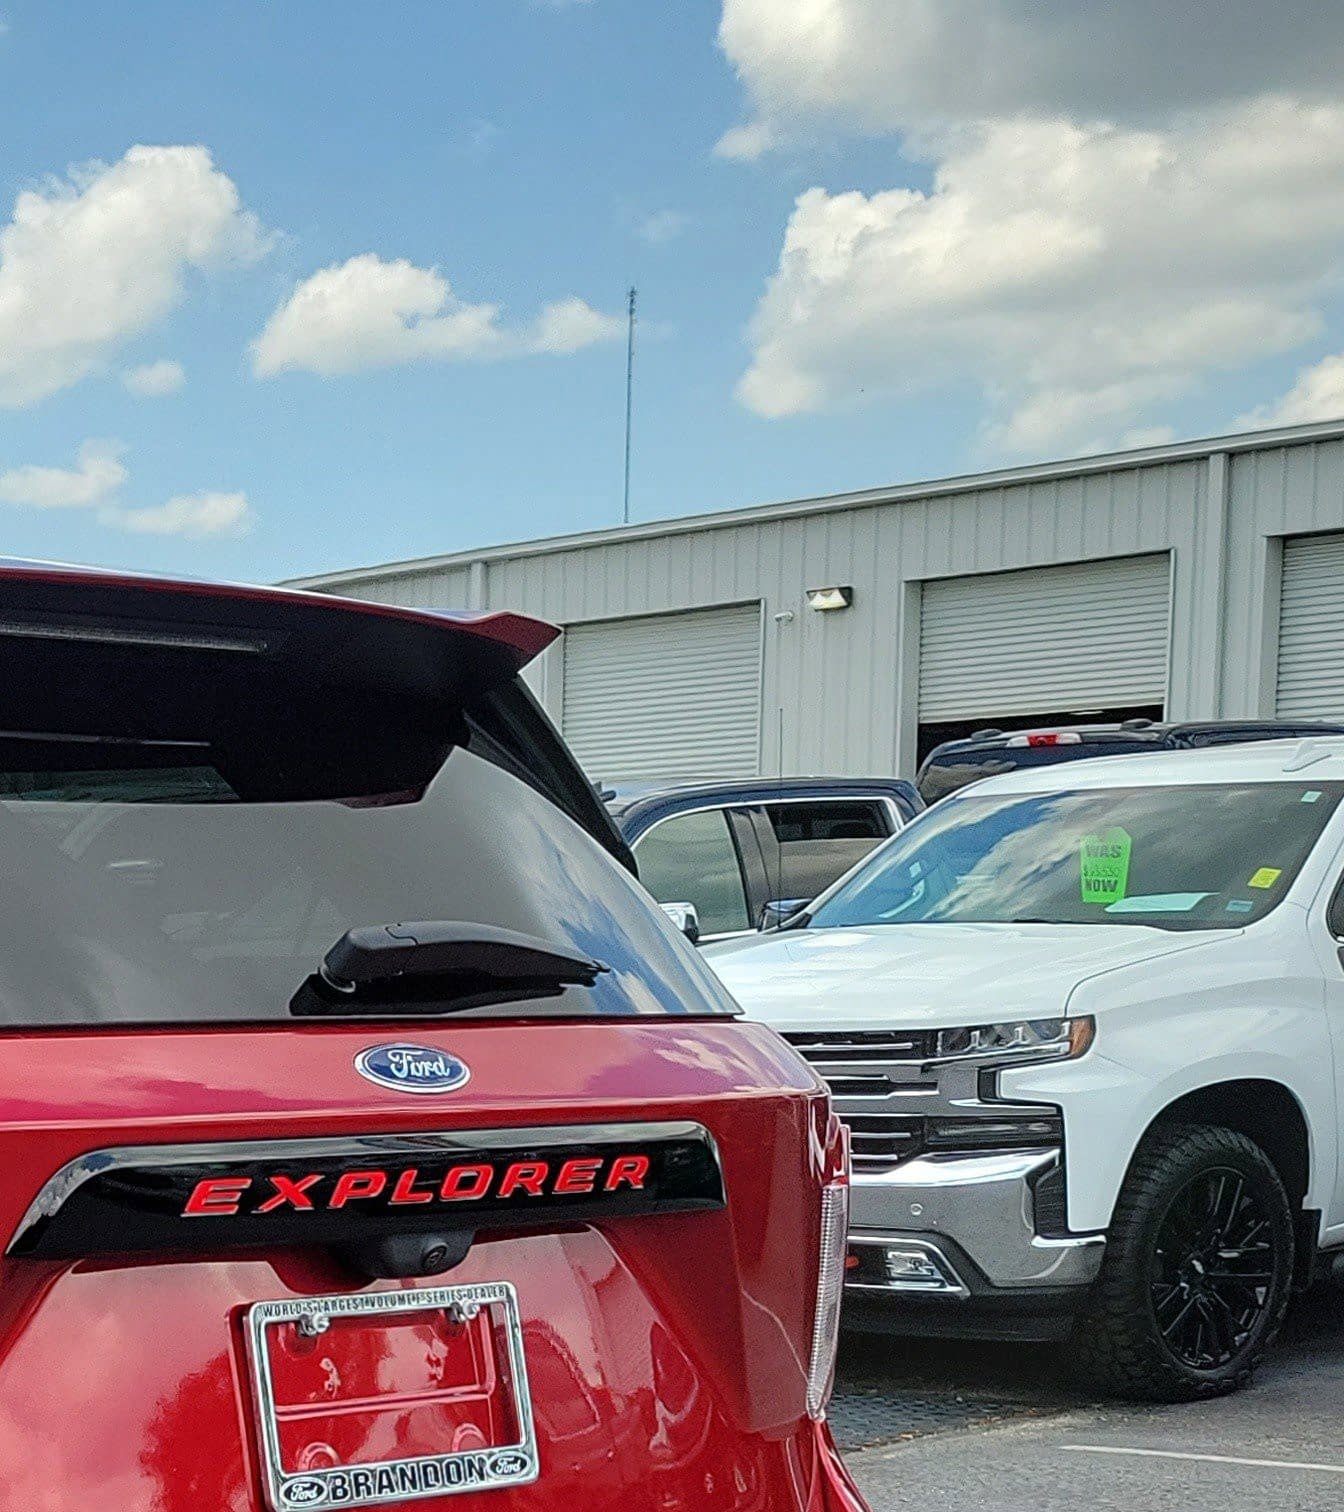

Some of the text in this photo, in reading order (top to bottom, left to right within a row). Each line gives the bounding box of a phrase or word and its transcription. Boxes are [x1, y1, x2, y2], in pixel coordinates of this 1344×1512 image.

[1085, 879, 1118, 893] NOW
[387, 1050, 450, 1078] Ford
[180, 1156, 649, 1217] EXPLORER
[289, 1454, 522, 1501] Ford BRANDON Ford
